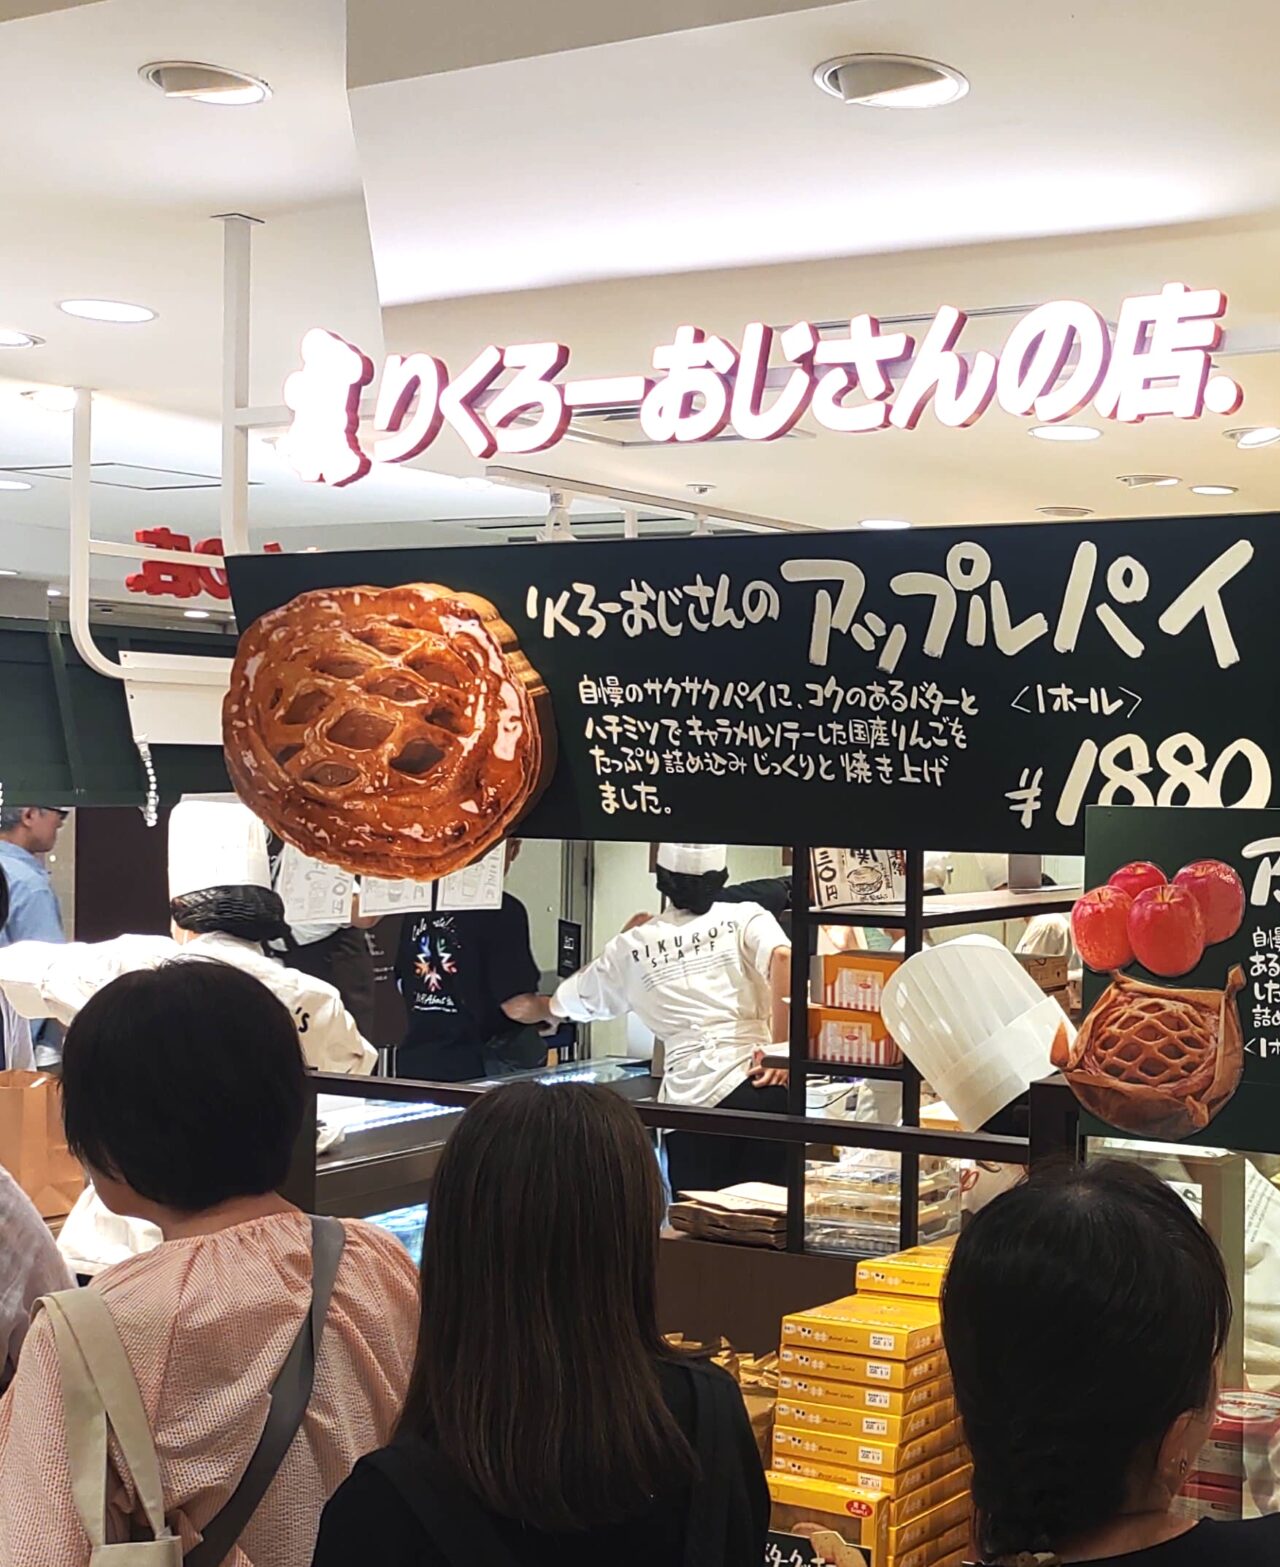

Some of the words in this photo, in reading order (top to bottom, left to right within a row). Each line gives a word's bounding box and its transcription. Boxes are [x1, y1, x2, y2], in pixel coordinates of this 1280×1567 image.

[780, 539, 1254, 673] アップルパイ
[599, 781, 672, 815] ました。
[632, 920, 735, 962] RIKURO'S
[651, 941, 716, 968] STAFF
